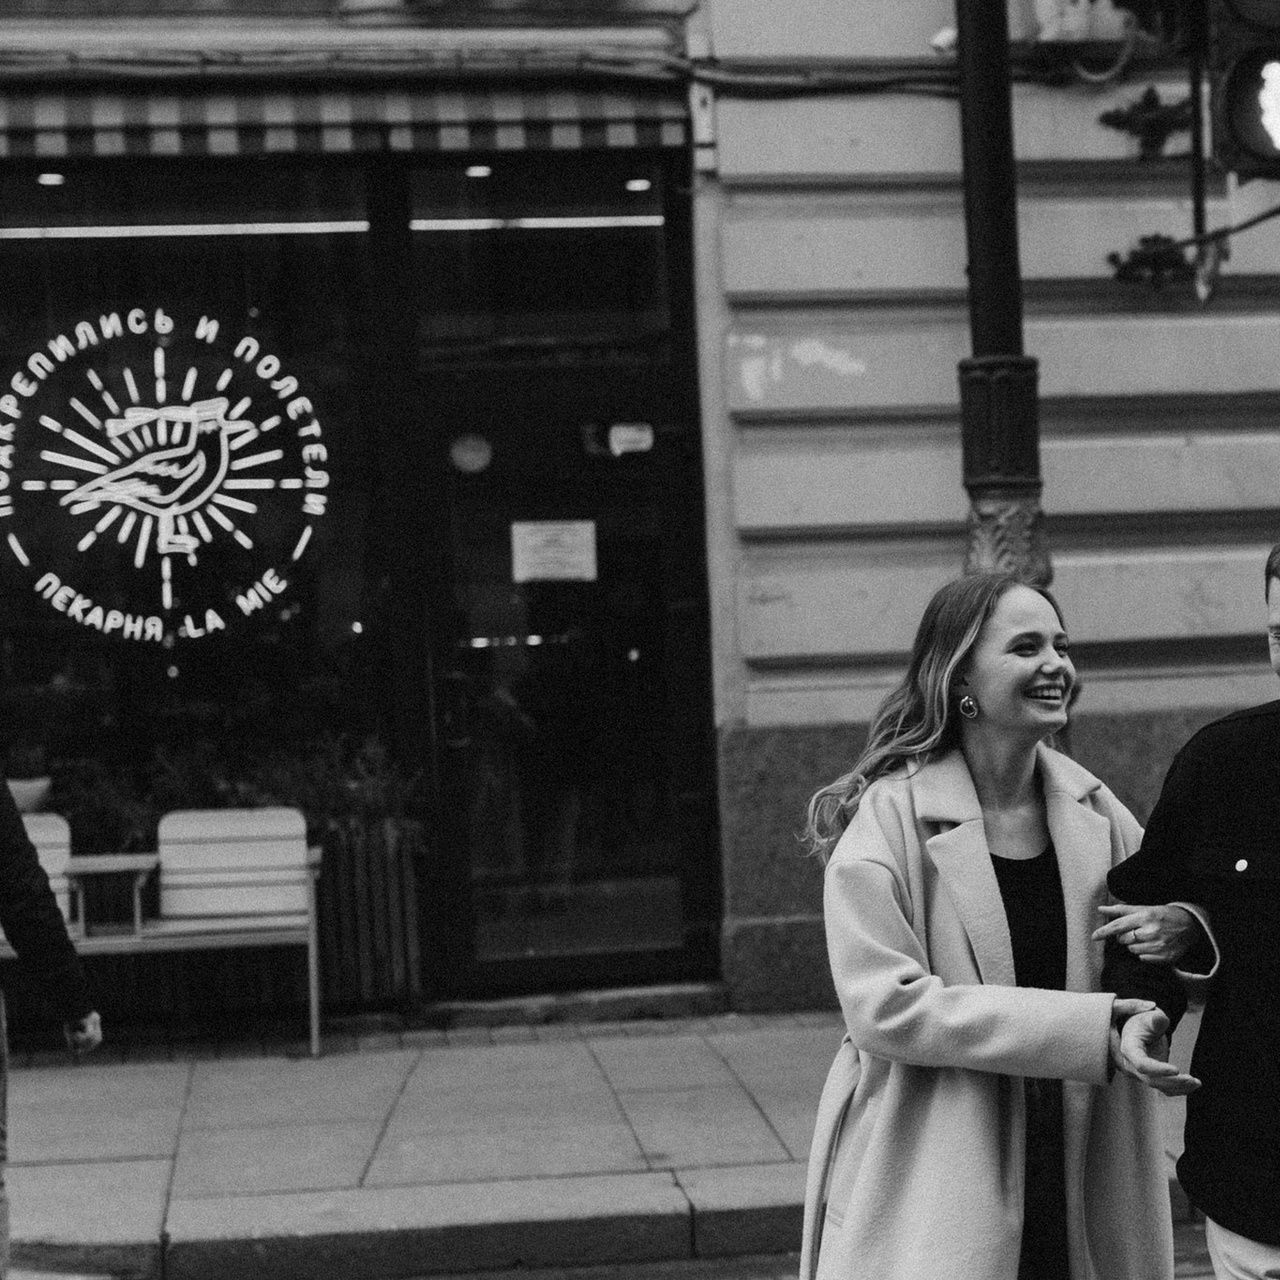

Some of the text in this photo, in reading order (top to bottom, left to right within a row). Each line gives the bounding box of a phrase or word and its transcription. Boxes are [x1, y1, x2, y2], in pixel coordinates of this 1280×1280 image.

[195, 315, 219, 344] И
[233, 336, 330, 515] ПОЛЕТЕЛИ
[34, 568, 288, 641] ПЕКАРНЯ LA MIE
